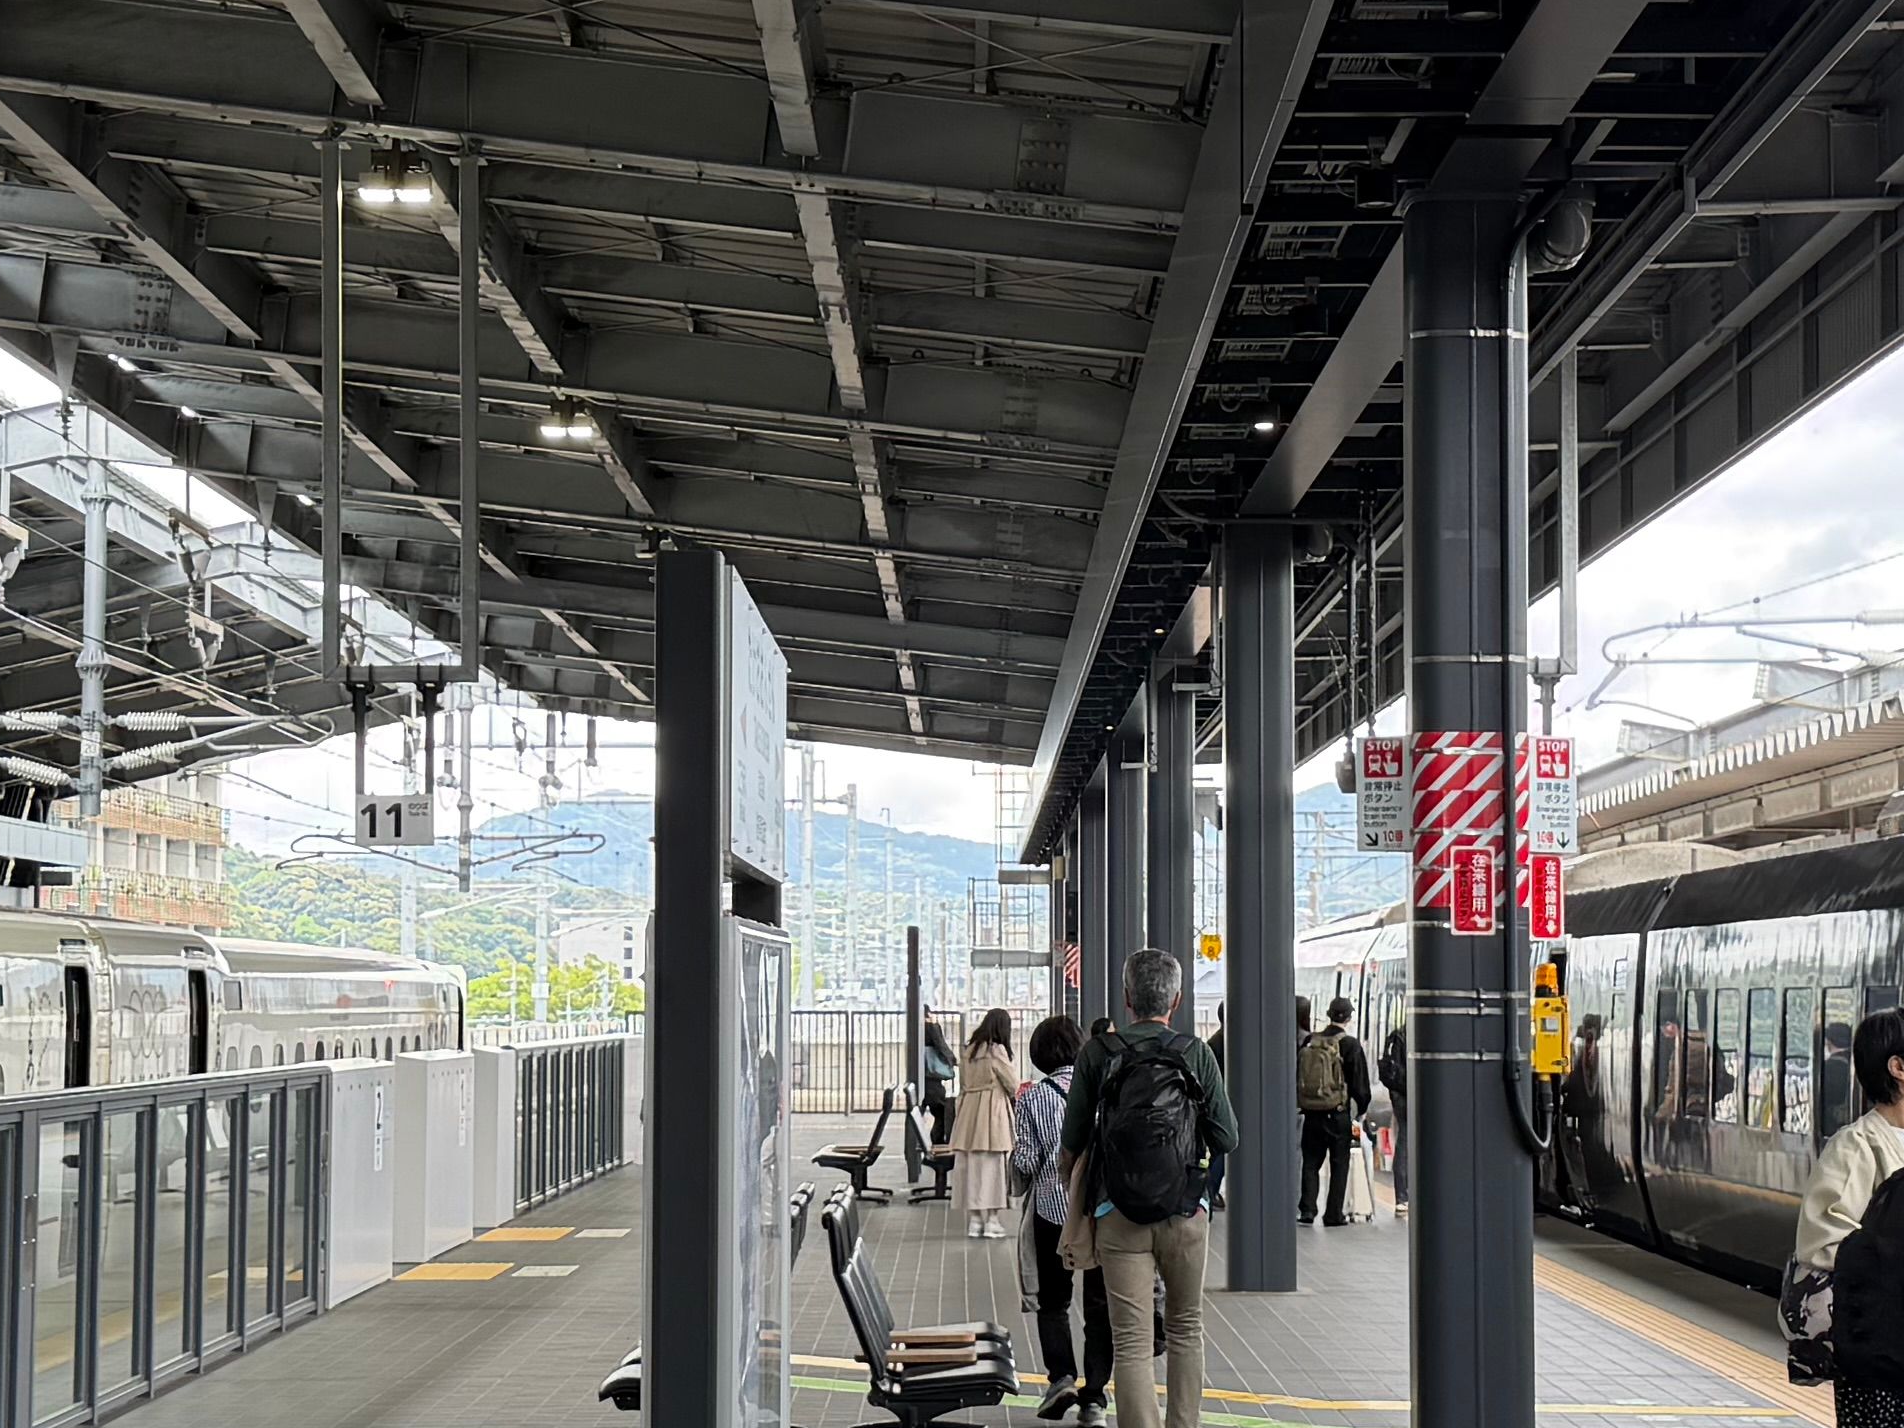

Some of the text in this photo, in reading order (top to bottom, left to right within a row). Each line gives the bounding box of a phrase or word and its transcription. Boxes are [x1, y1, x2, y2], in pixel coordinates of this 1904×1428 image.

[1366, 740, 1400, 752] STOP
[1538, 741, 1567, 753] STOP
[360, 803, 402, 839] 11
[1472, 853, 1487, 913] 在来線用
